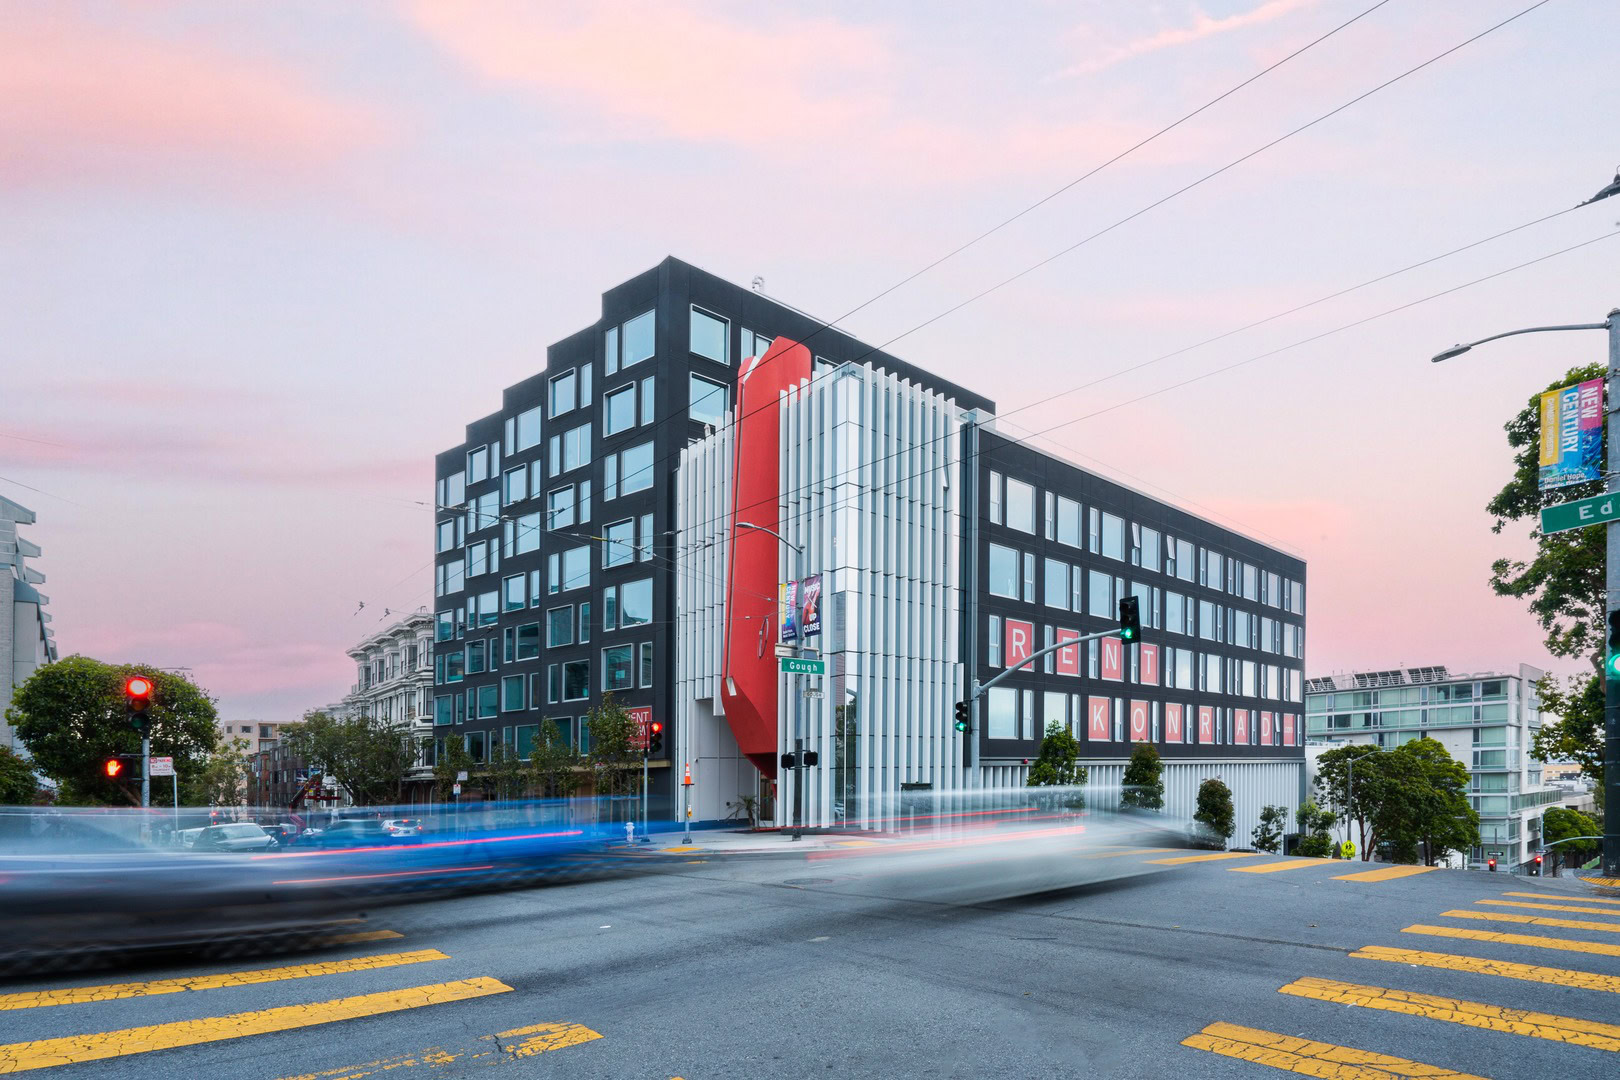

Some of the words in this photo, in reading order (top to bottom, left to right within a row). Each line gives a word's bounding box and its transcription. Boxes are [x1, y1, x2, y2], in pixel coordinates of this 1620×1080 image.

[1581, 387, 1598, 419] NEW
[1562, 392, 1579, 453] CENTURY
[1579, 501, 1620, 520] Ed
[803, 622, 820, 633] CLOSE
[1012, 629, 1154, 676] RENT
[789, 661, 818, 673] Gough
